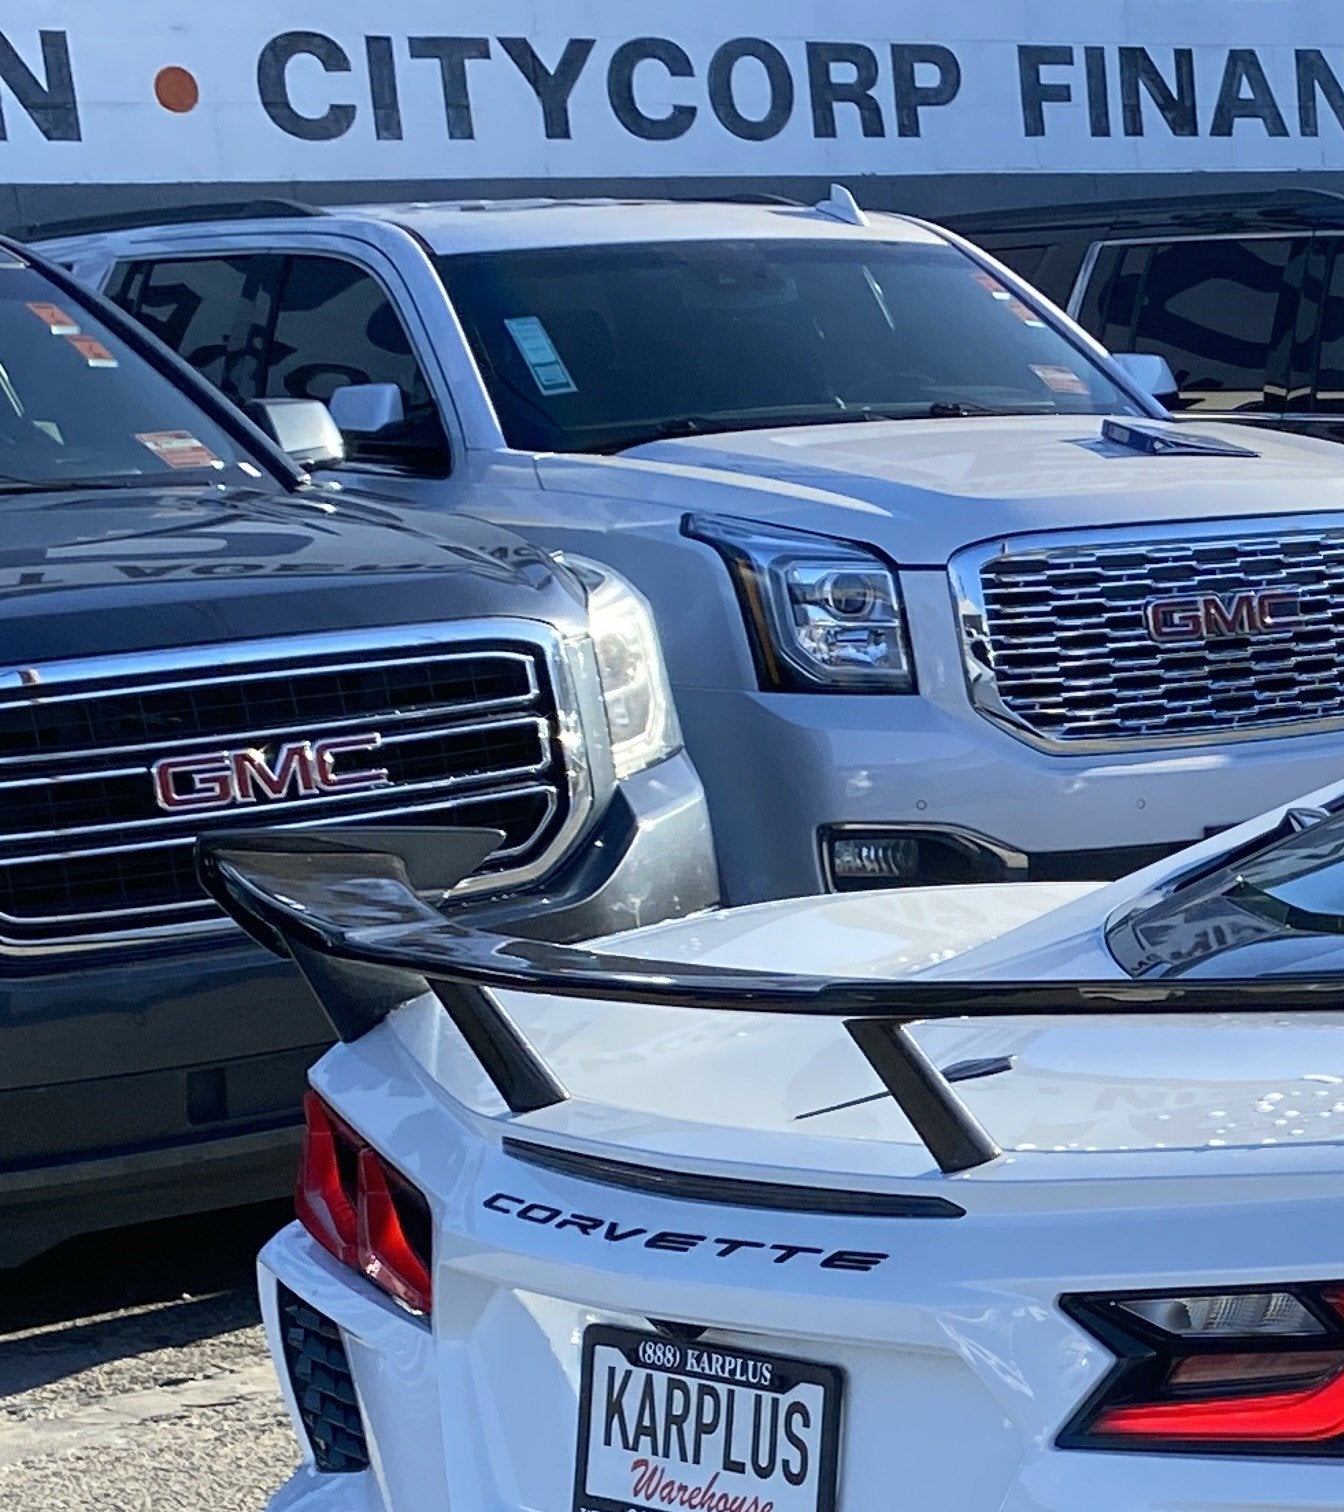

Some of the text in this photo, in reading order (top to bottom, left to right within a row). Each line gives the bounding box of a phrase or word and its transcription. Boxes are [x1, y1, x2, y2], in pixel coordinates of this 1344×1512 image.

[257, 30, 962, 142] CITYCORP
[1146, 586, 1306, 642] GMC
[151, 732, 392, 811] GMC
[482, 1192, 890, 1273] CORVETTE
[638, 1341, 774, 1386] (888) KARPLUS
[603, 1365, 812, 1486] KARPLUS
